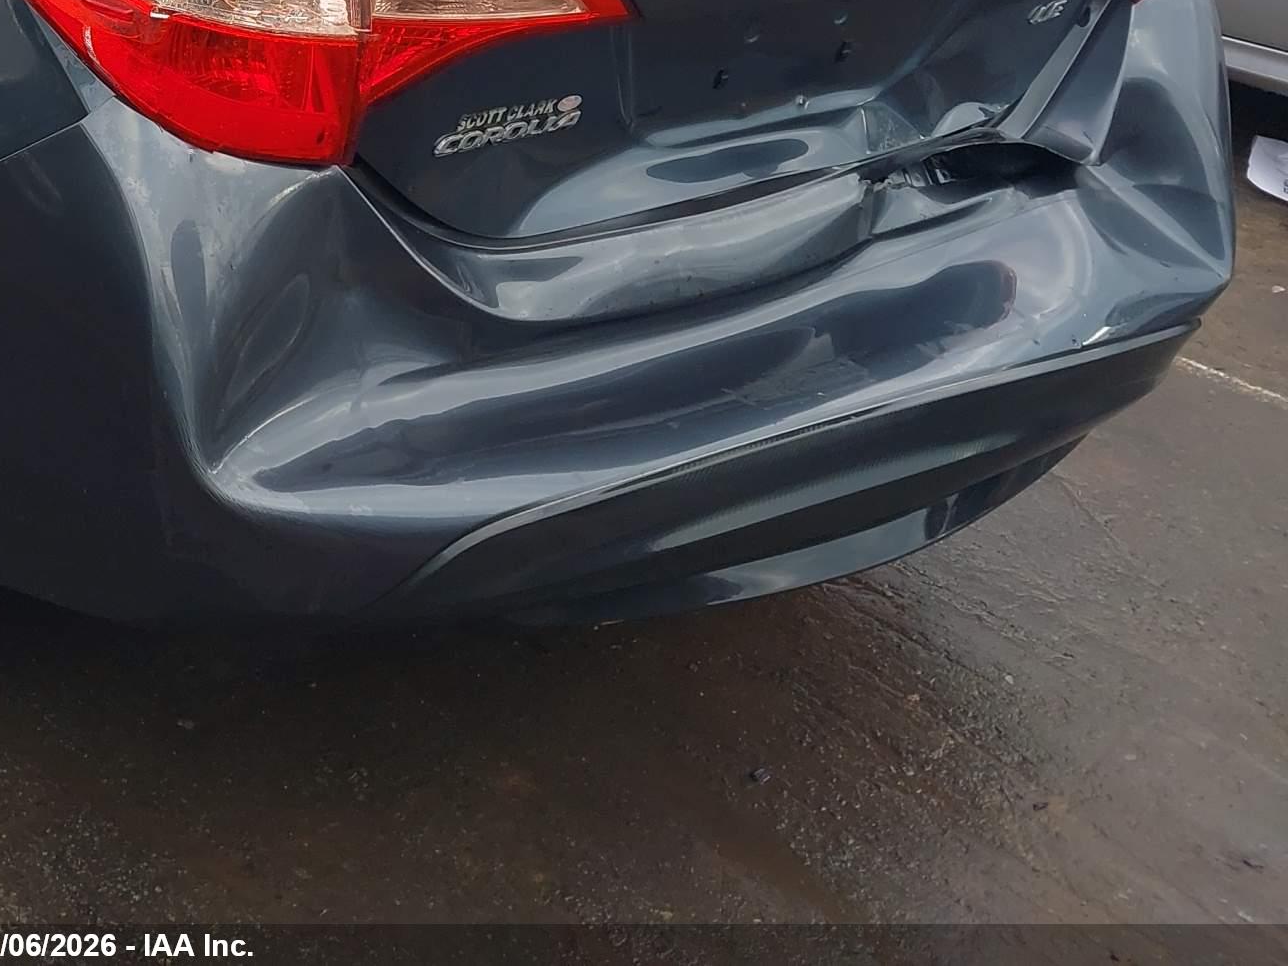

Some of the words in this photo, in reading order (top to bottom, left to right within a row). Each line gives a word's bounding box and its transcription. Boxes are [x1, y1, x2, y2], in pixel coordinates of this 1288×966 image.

[1029, 0, 1068, 25] LE
[456, 106, 508, 132] SCOTT
[507, 99, 558, 122] CLARK
[434, 110, 582, 156] COROLLA
